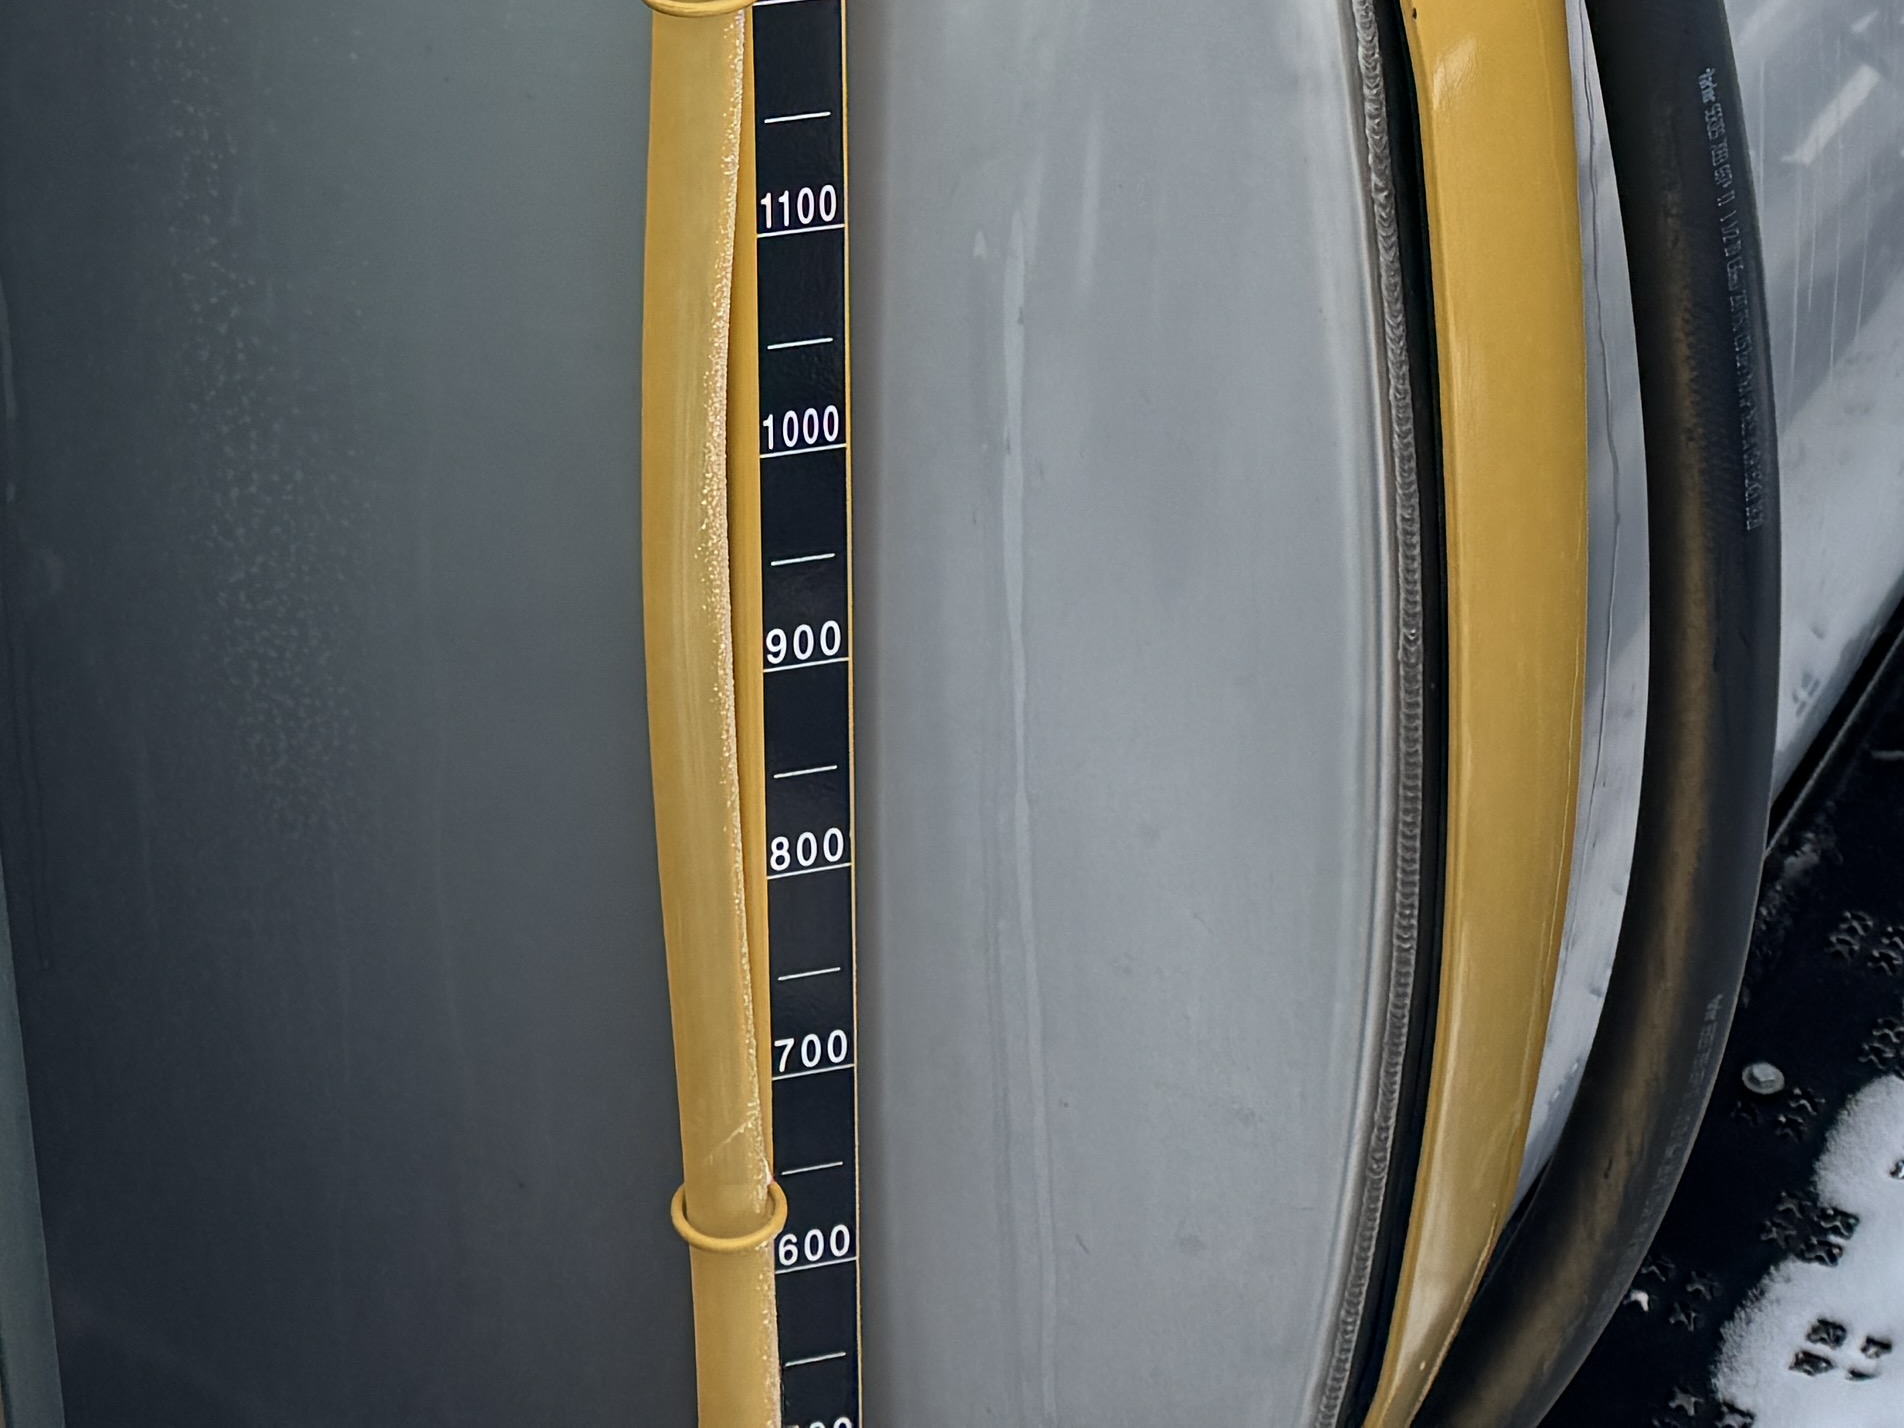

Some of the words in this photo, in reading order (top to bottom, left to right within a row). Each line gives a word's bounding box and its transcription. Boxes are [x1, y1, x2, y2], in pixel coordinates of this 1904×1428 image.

[760, 185, 838, 230] 1100
[762, 405, 840, 450] 1000
[766, 620, 842, 663] 900
[770, 826, 844, 872] 800
[774, 1029, 849, 1073] 700
[778, 1224, 851, 1266] 600
